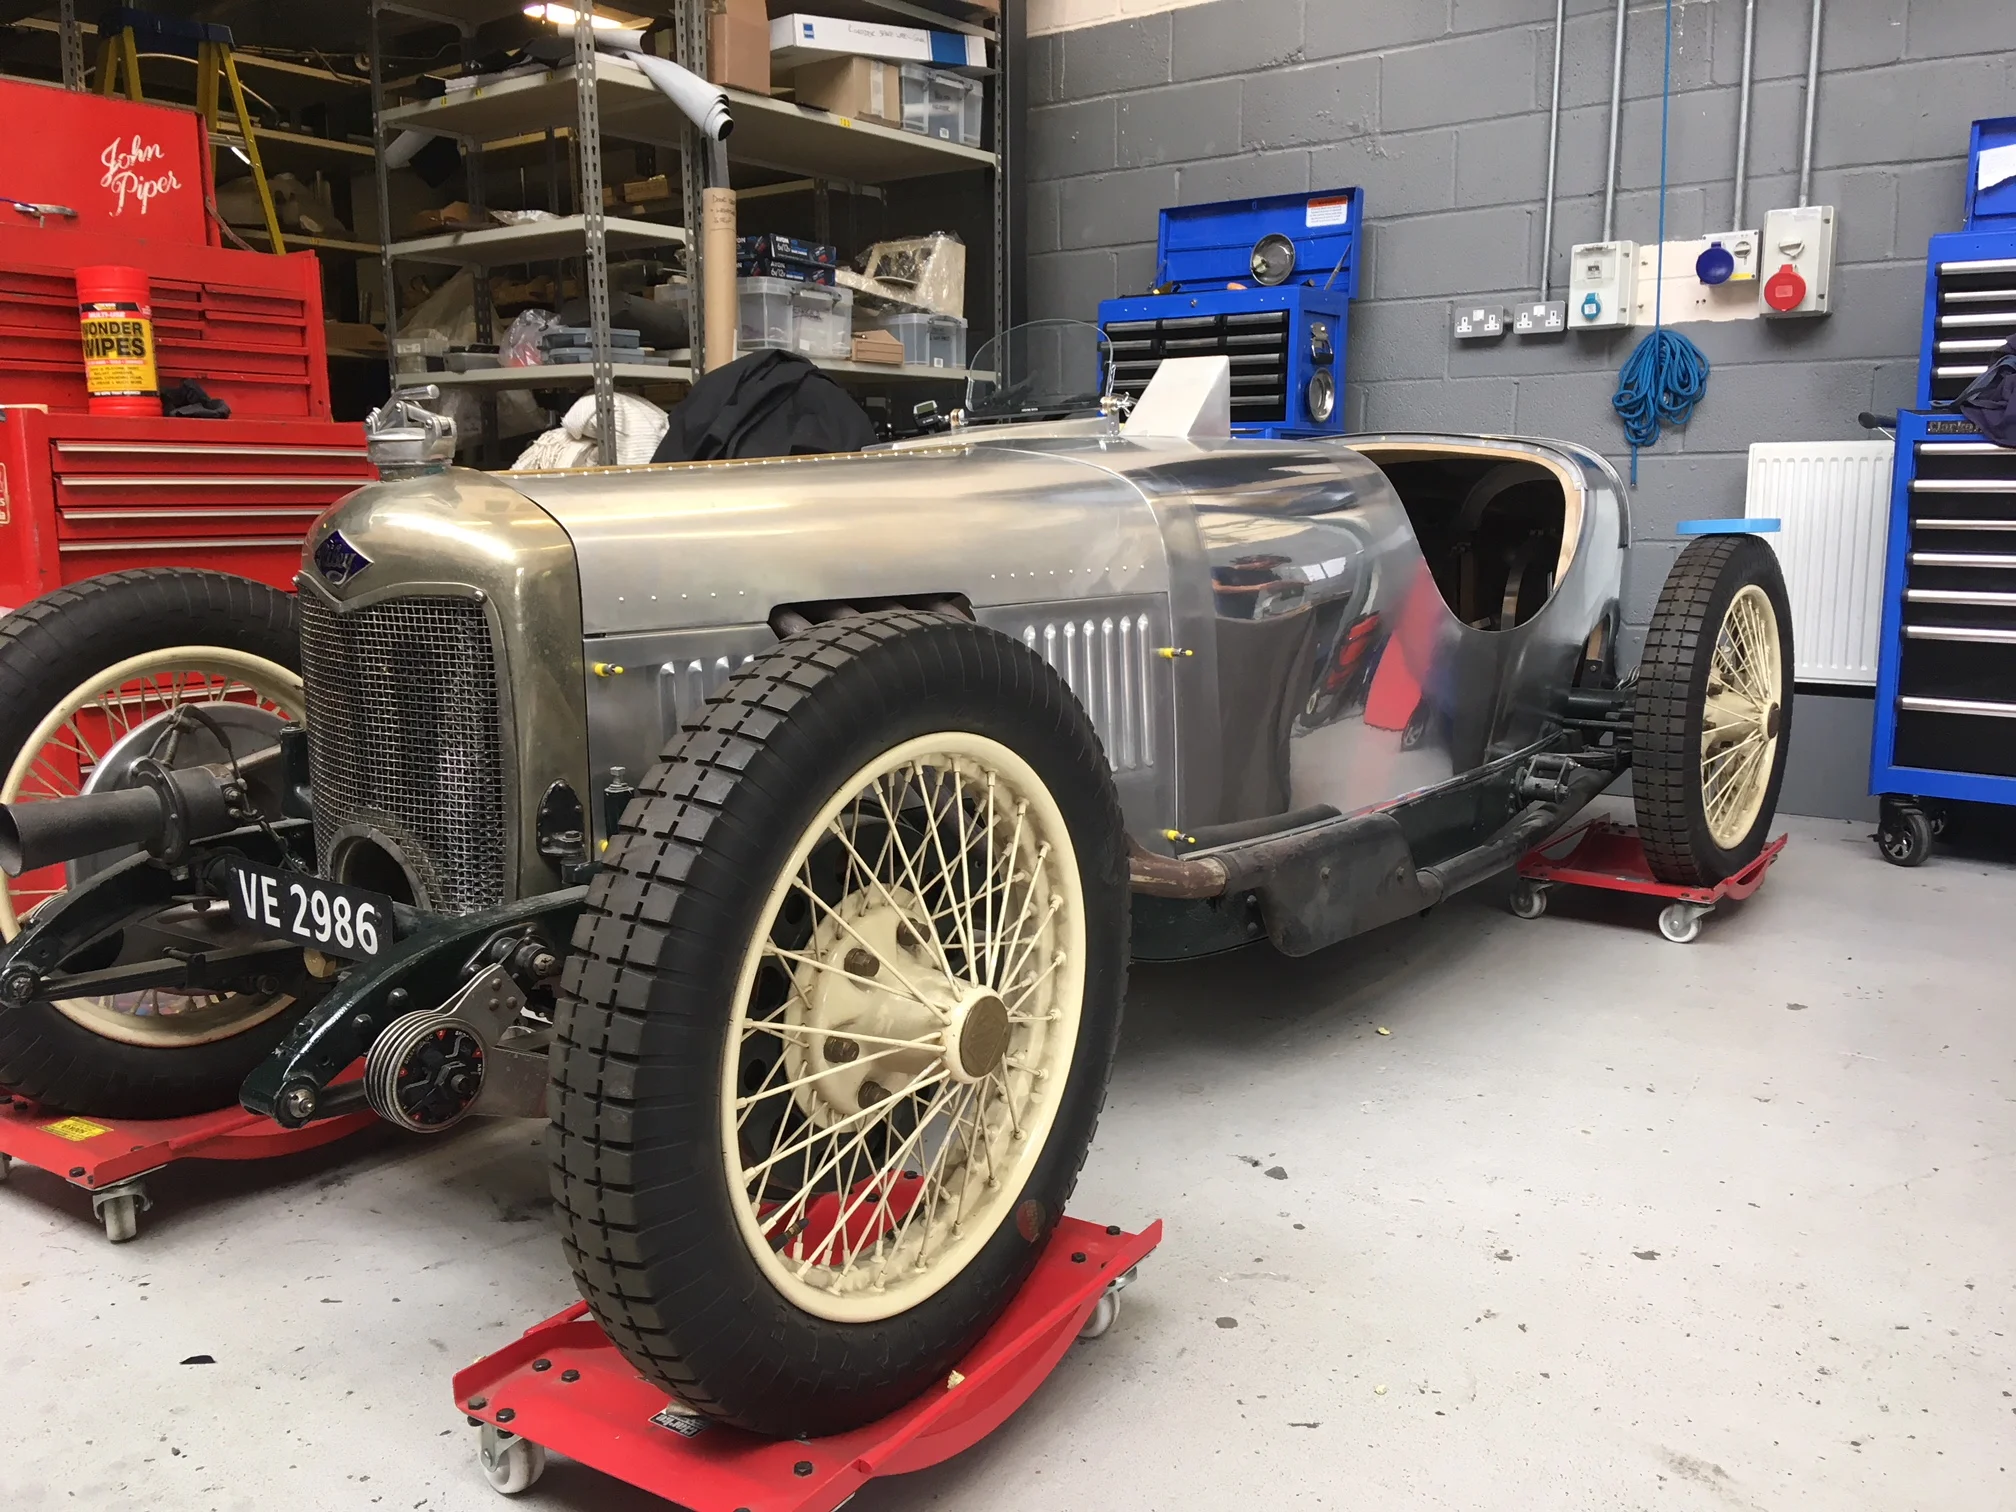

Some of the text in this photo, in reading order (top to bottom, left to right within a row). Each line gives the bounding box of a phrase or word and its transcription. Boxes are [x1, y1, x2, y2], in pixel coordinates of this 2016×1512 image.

[100, 135, 164, 187] John
[109, 169, 182, 216] Piper
[238, 869, 378, 955] VE 2986
